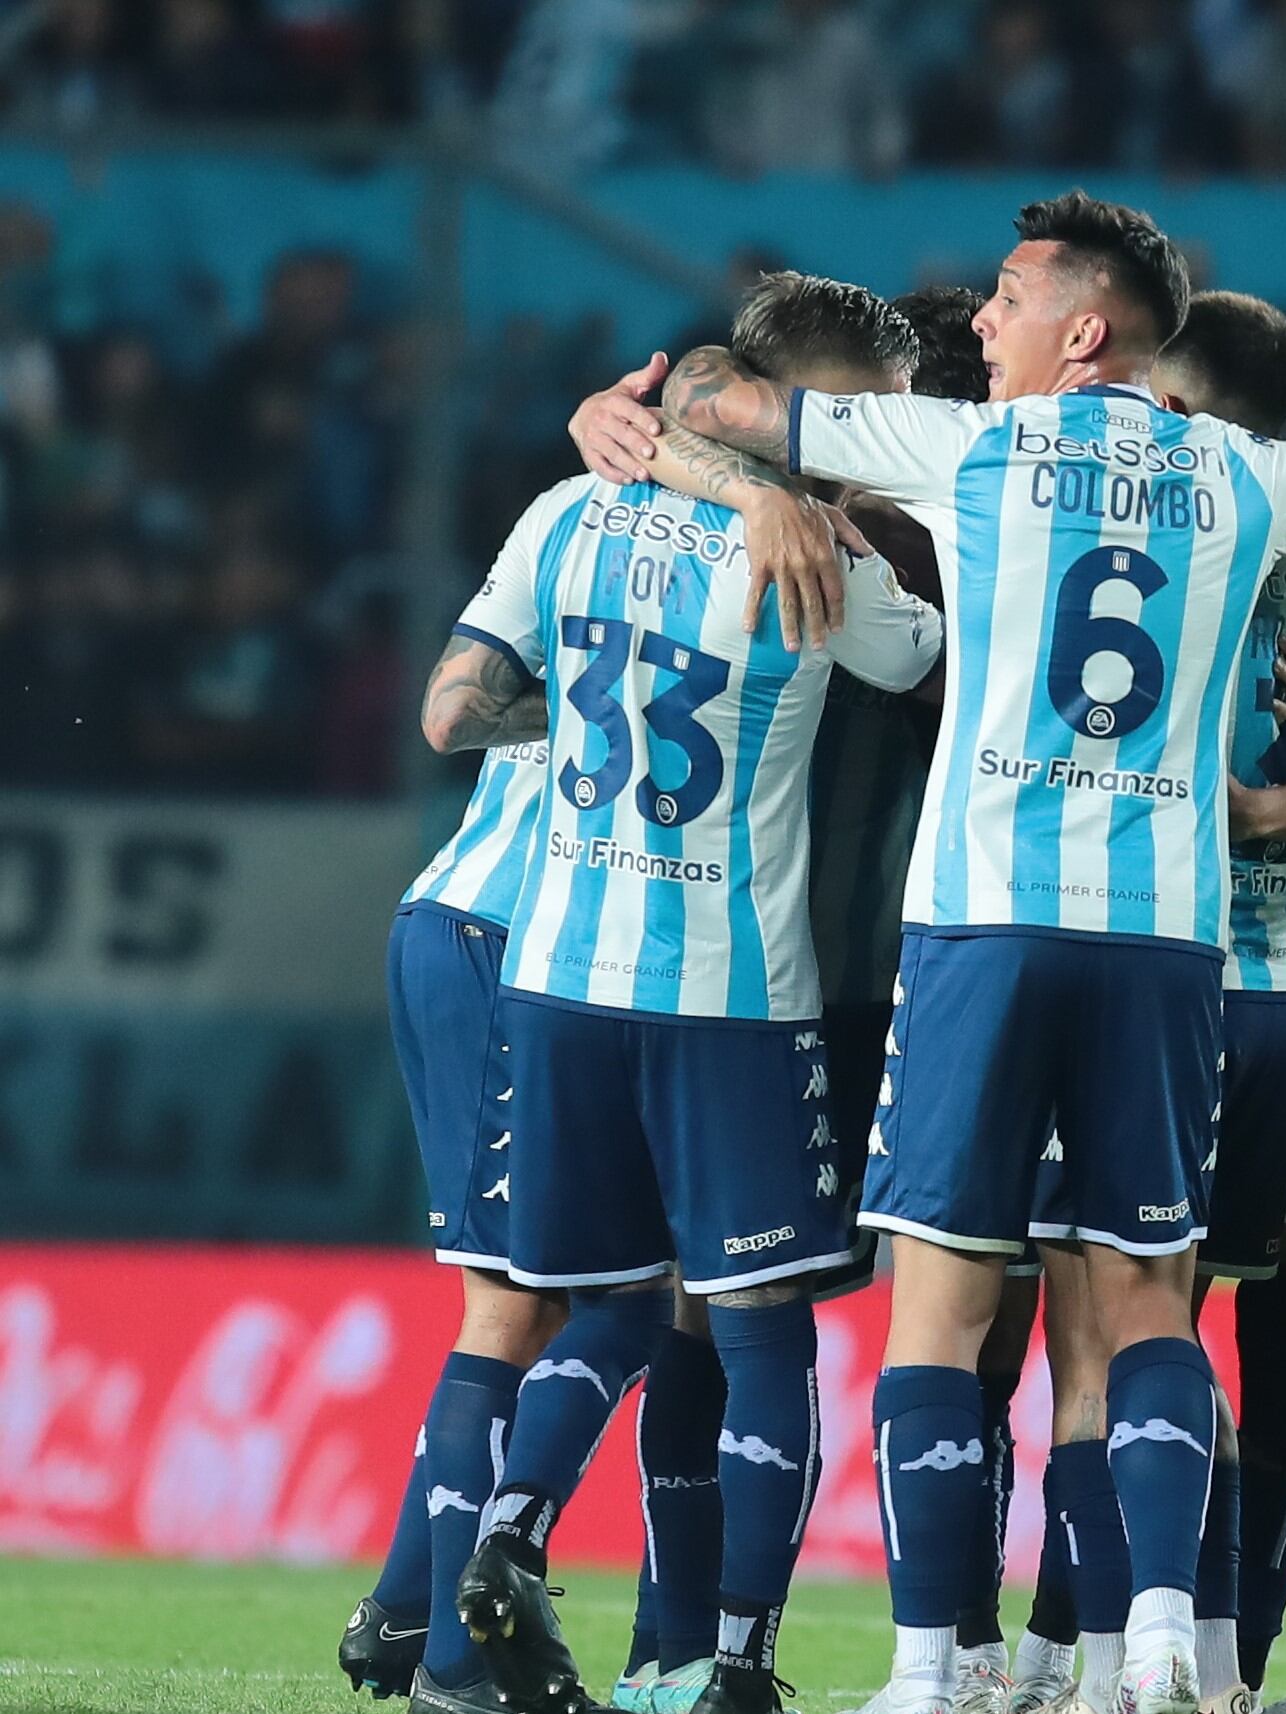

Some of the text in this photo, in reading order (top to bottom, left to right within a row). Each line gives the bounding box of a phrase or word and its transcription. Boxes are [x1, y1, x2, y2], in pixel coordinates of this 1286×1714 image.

[1015, 422, 1225, 477] betsson
[1030, 461, 1216, 533] COLOMBO
[1047, 544, 1171, 740] 6
[557, 614, 731, 828] 33
[978, 748, 1190, 800] Sur Finanzas
[550, 831, 723, 883] Sur Finanzas
[1007, 881, 1161, 903] EL PRIMER GRANDE
[545, 952, 688, 980] EL PRIMER GRANDE
[1139, 1197, 1190, 1222] Kapp
[724, 1225, 796, 1255] Kappa
